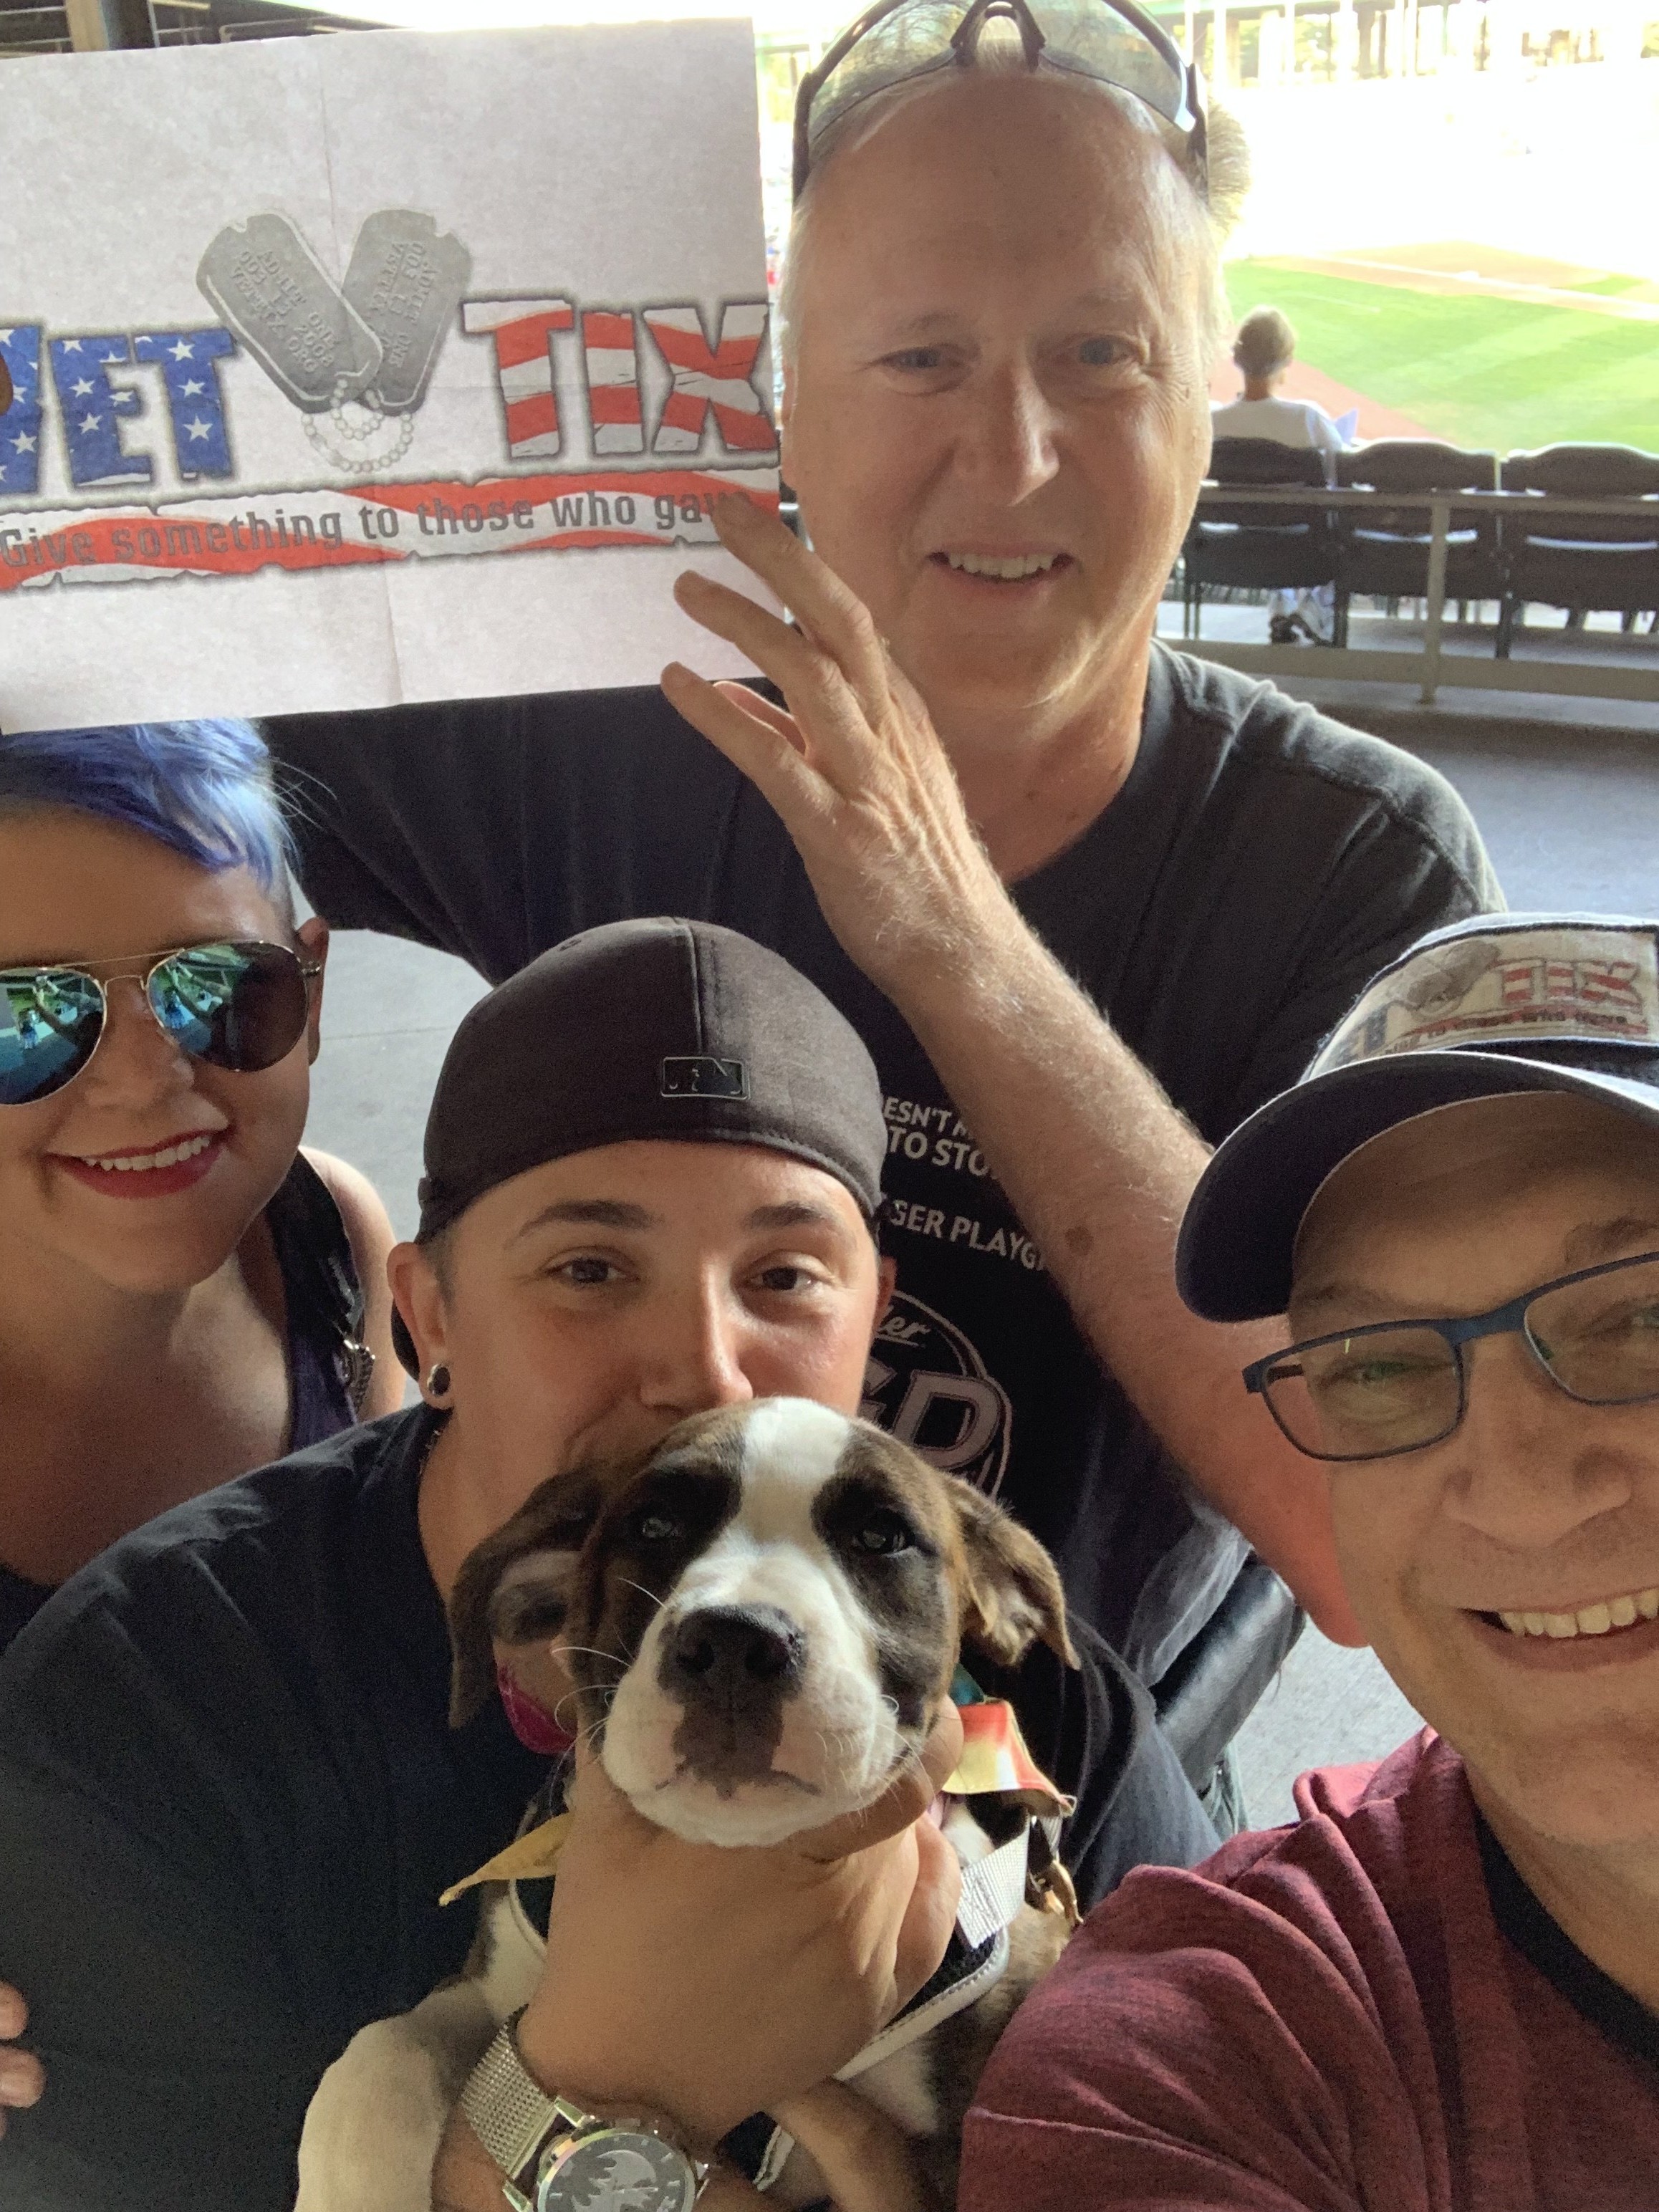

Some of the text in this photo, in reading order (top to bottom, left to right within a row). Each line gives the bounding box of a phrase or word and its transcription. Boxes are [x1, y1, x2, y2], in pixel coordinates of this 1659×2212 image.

[461, 296, 779, 460] TIX
[0, 489, 727, 569] Give something to those who ga
[883, 1097, 952, 1133] ESN'T
[889, 1125, 928, 1160] TO
[932, 1139, 998, 1180] STO
[889, 1199, 1044, 1271] SER PLAYG
